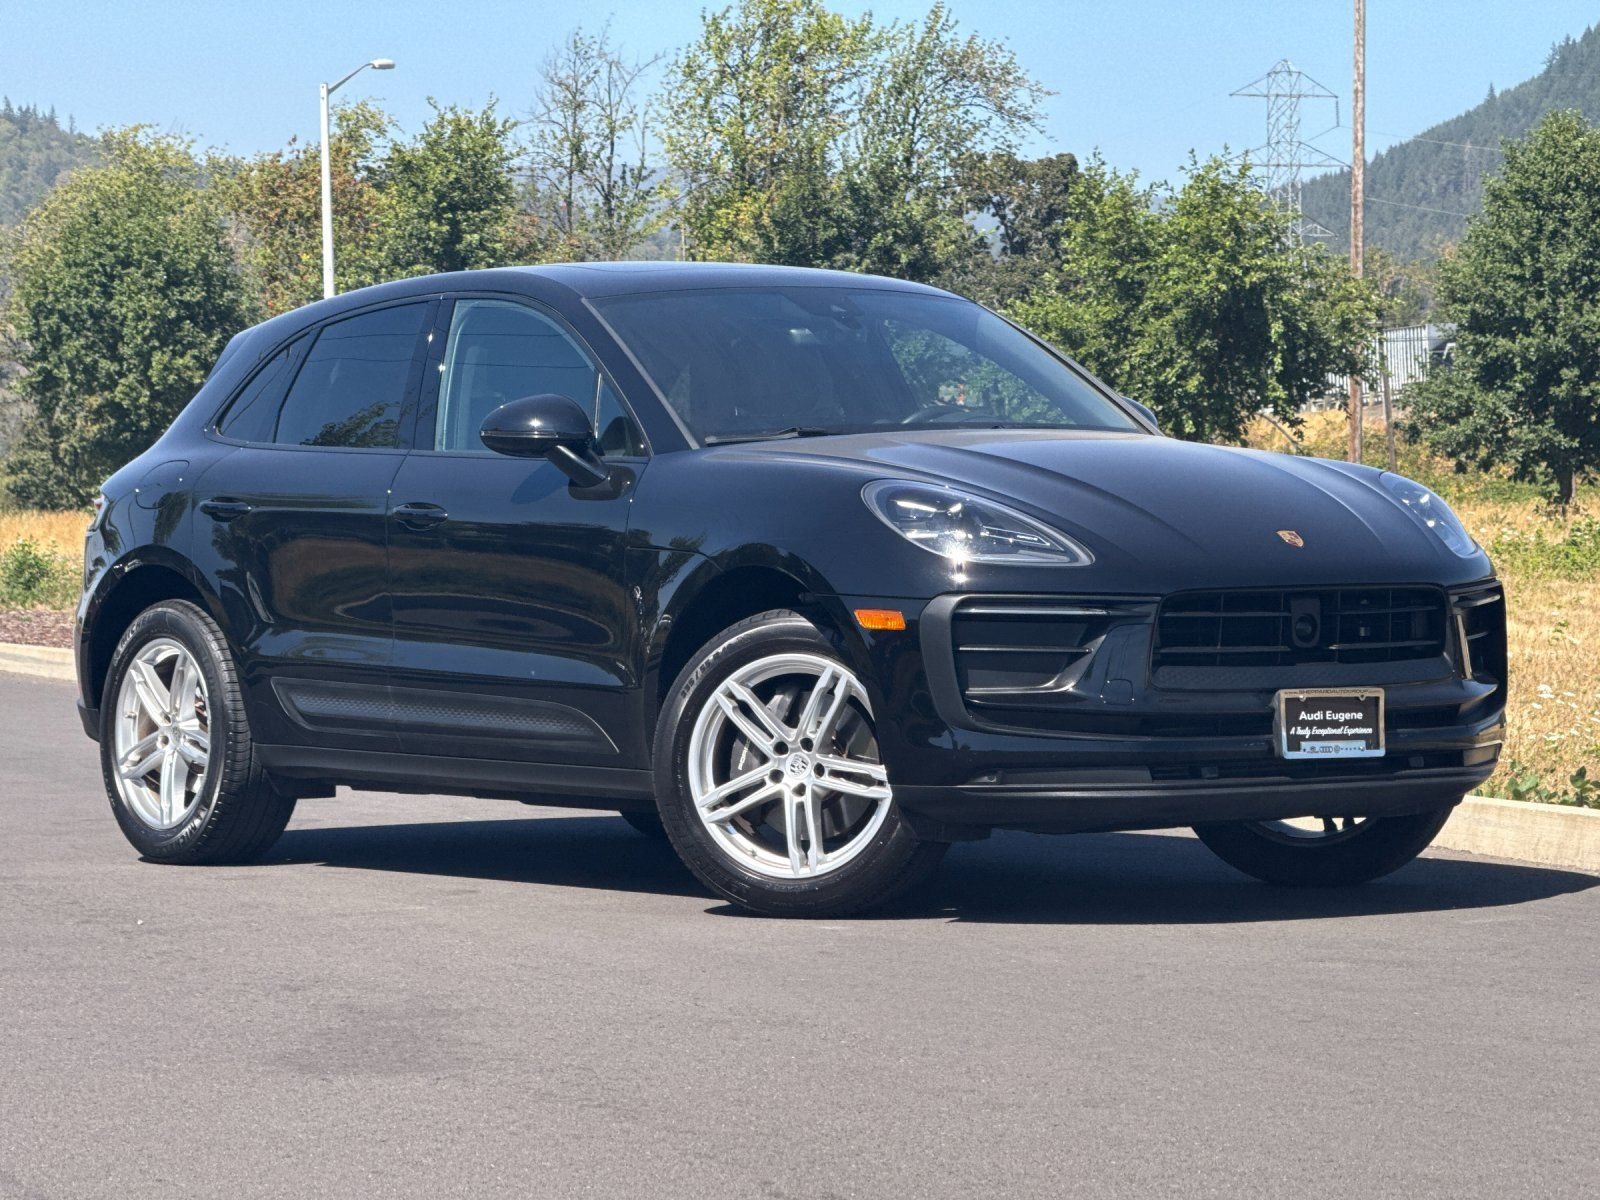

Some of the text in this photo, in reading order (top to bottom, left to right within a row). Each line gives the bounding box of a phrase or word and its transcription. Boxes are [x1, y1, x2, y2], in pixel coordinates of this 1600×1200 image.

[1299, 710, 1363, 722] Audi Eugene
[1290, 726, 1295, 735] A
[1311, 726, 1343, 737] Exceptional
[1343, 725, 1373, 736] Experience
